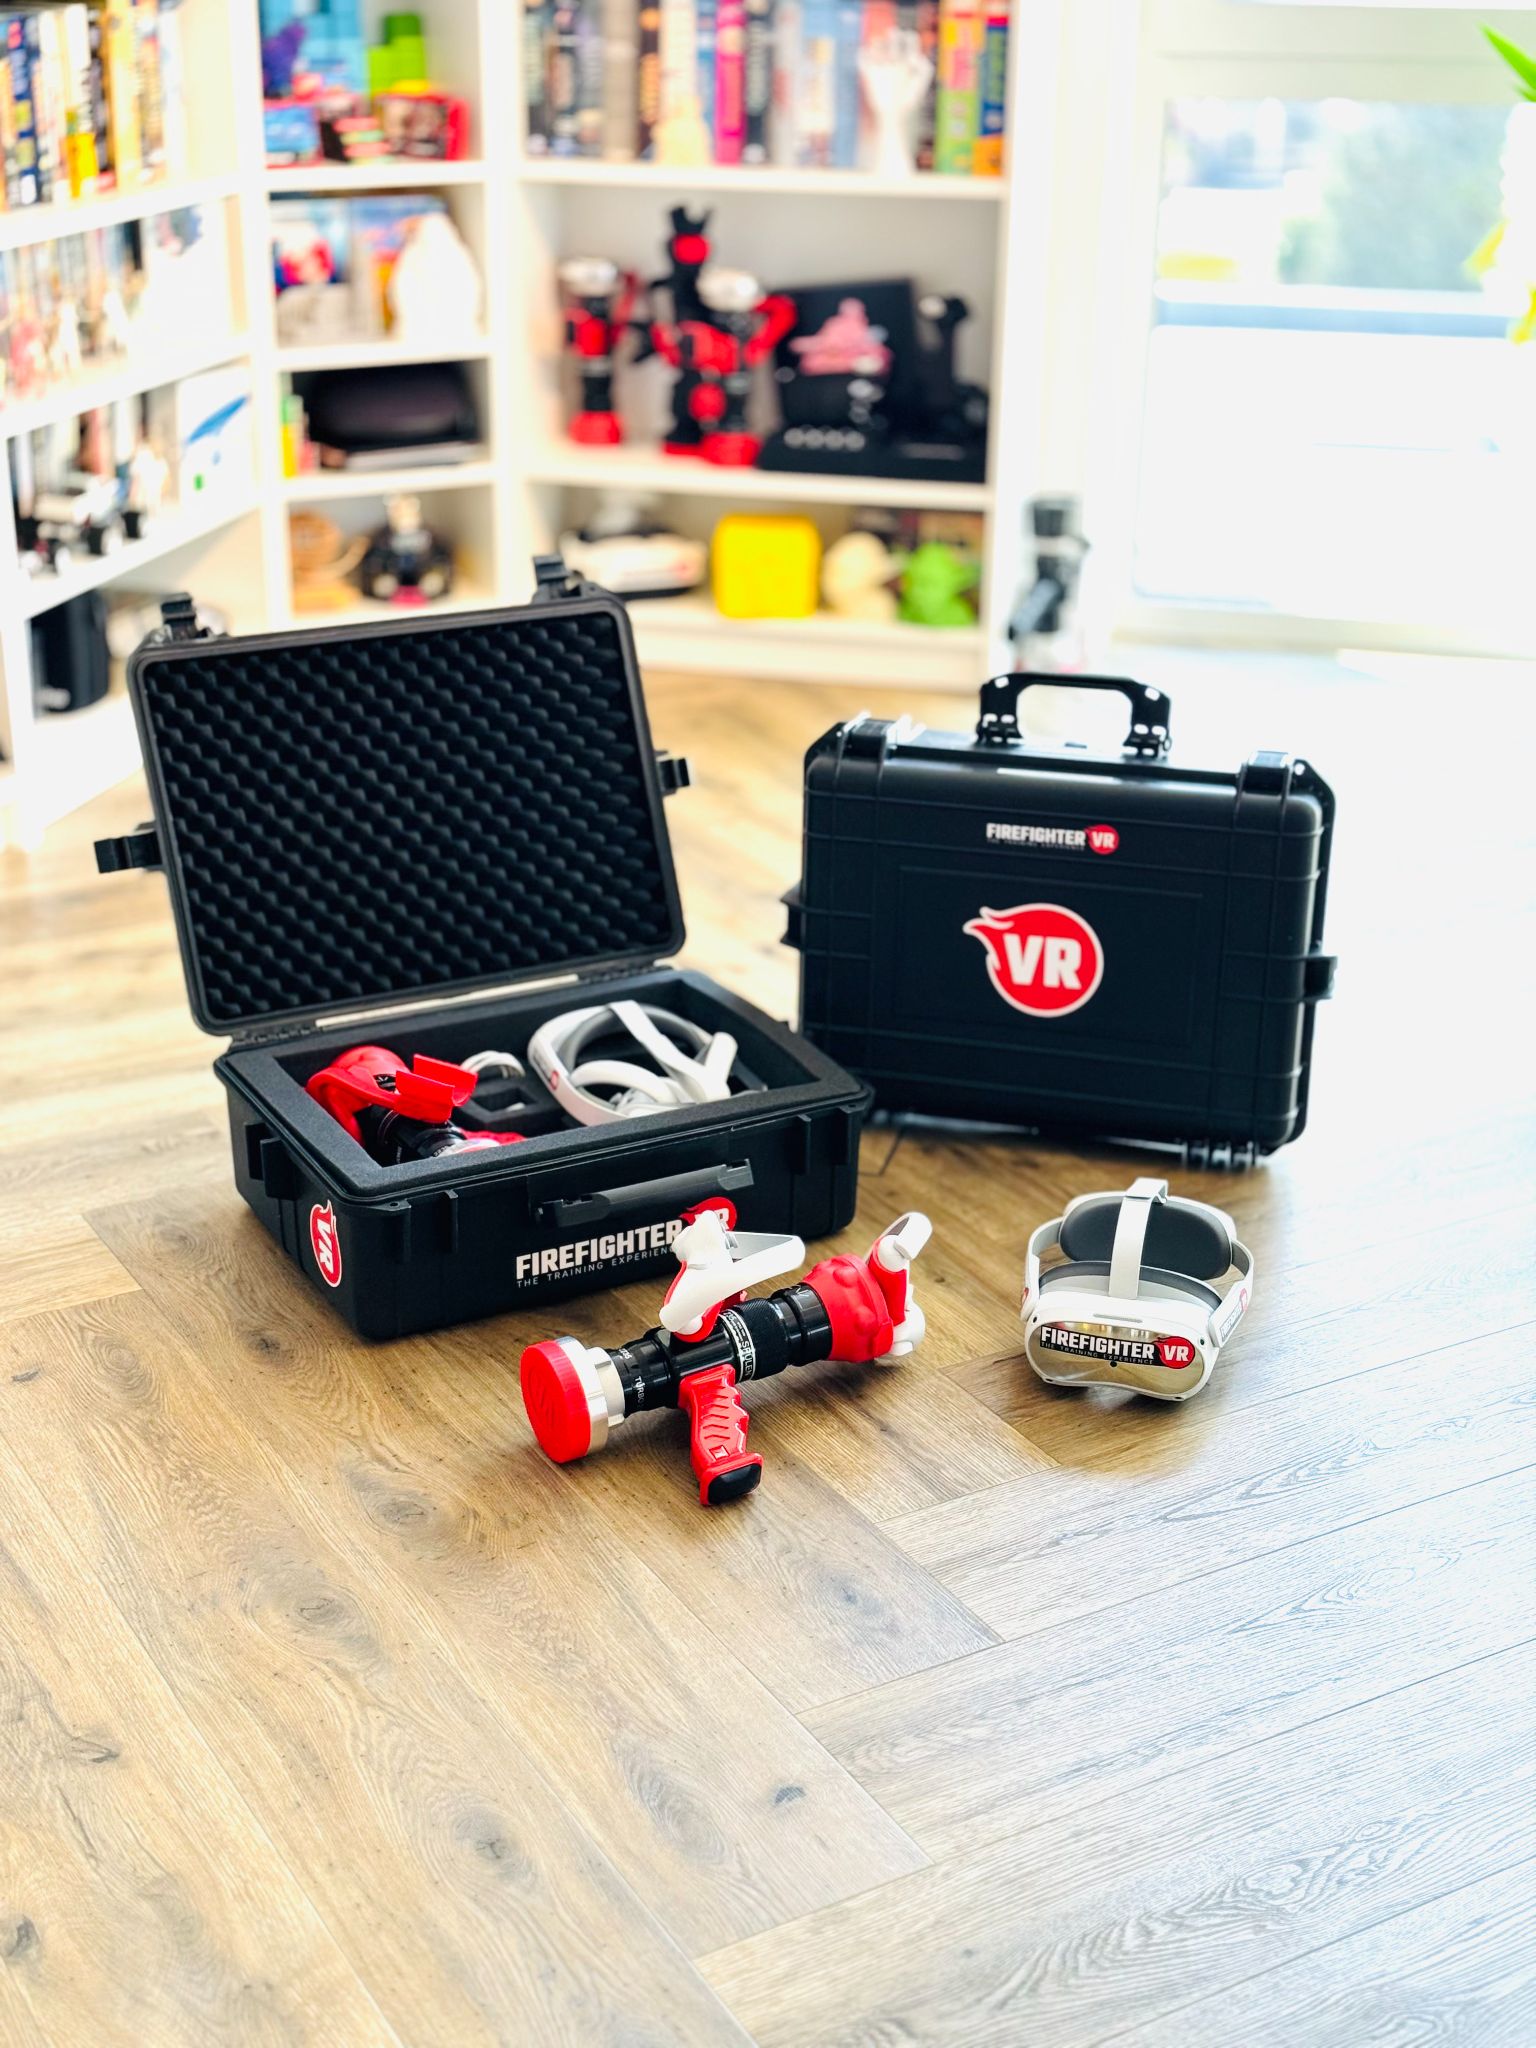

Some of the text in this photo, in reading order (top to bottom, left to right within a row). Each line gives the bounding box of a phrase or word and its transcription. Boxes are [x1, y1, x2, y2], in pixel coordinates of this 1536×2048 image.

[986, 823, 1085, 846] FIREFIGHTER
[1092, 832, 1115, 848] VR
[1003, 933, 1081, 990] VR
[317, 1218, 334, 1273] VR
[516, 1220, 683, 1280] FIREFIGHTER
[517, 1278, 538, 1288] THE
[548, 1262, 604, 1281] TRAINING
[1041, 1326, 1189, 1361] FIREFIGHTER VR
[1060, 1345, 1099, 1358] TRAINING
[1103, 1352, 1154, 1365] EXPERIENCE
